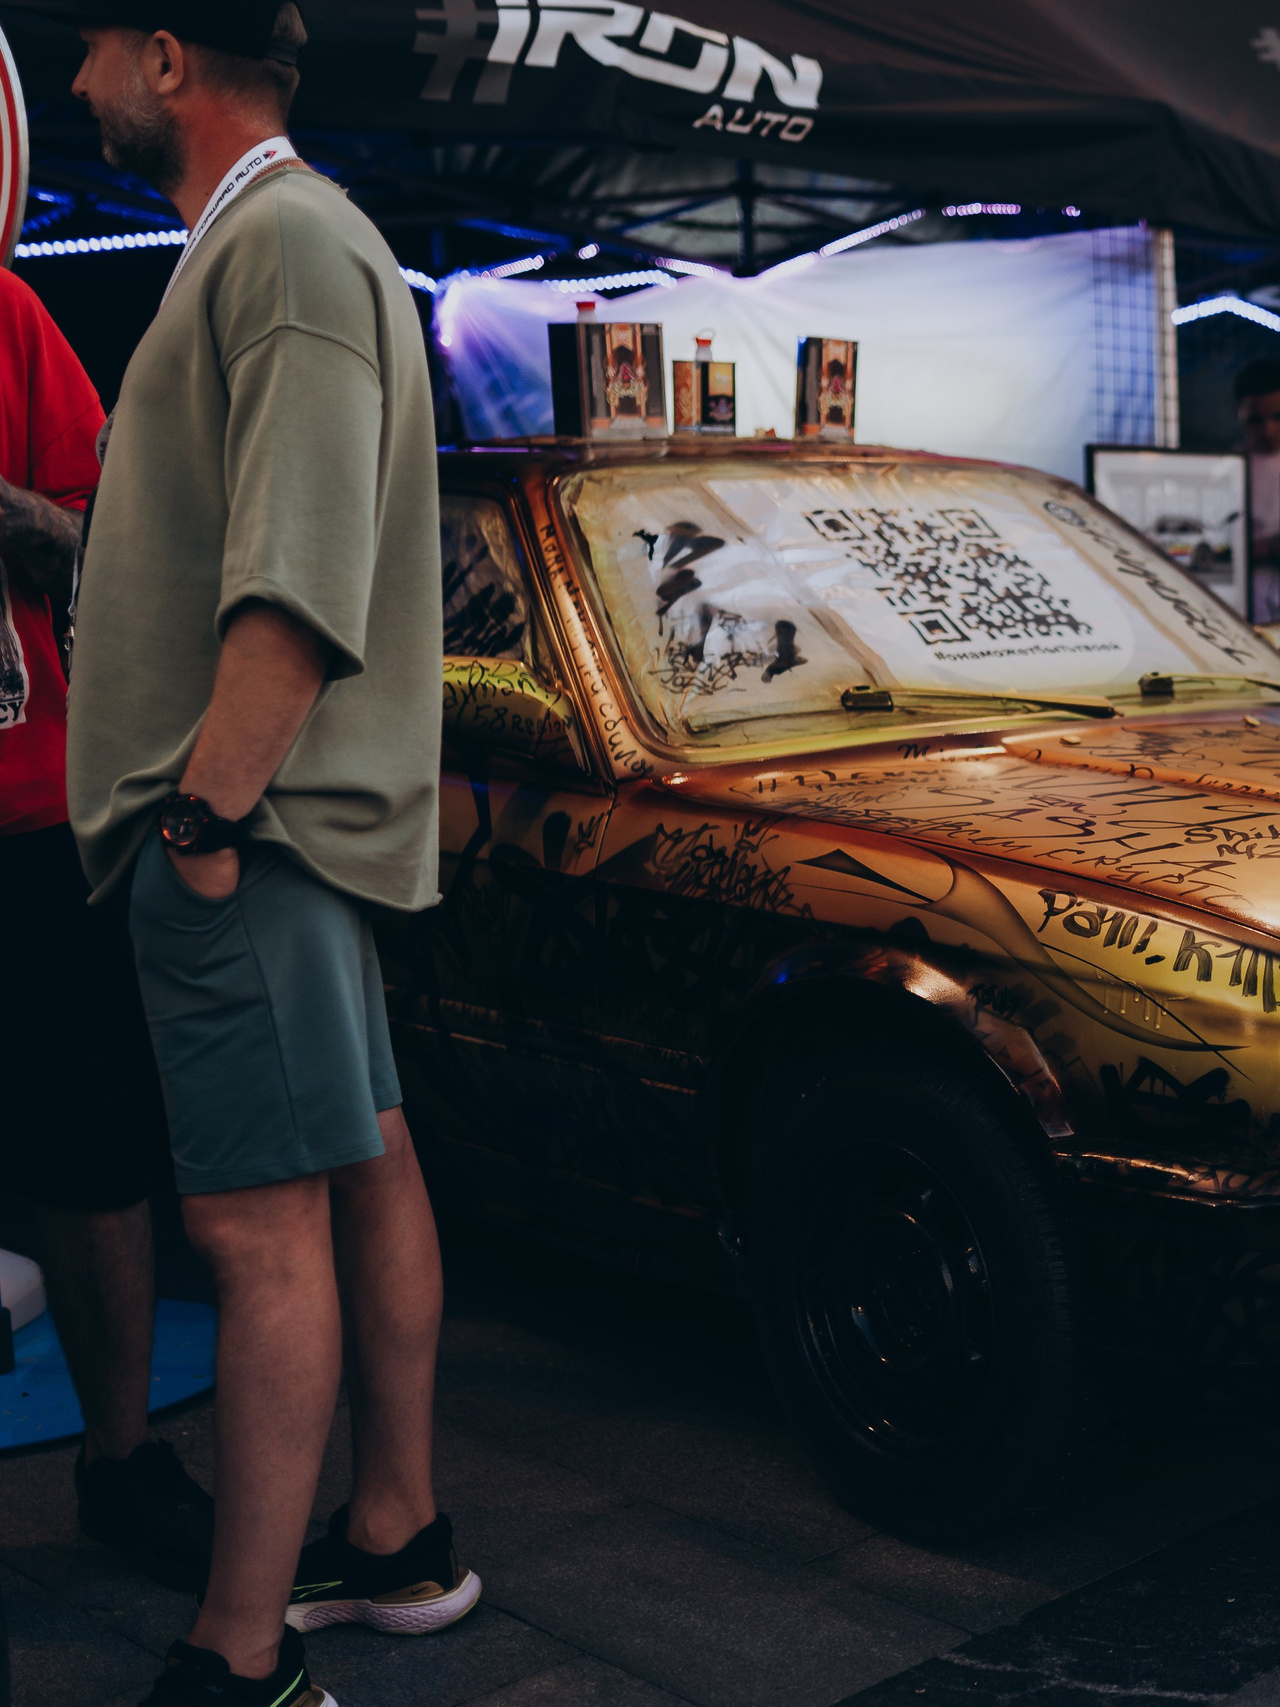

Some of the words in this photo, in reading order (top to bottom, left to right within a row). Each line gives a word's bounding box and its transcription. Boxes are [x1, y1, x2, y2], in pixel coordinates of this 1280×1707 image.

[692, 103, 815, 143] AUTO
[197, 182, 235, 236] FORWARD
[235, 156, 263, 183] AUTO
